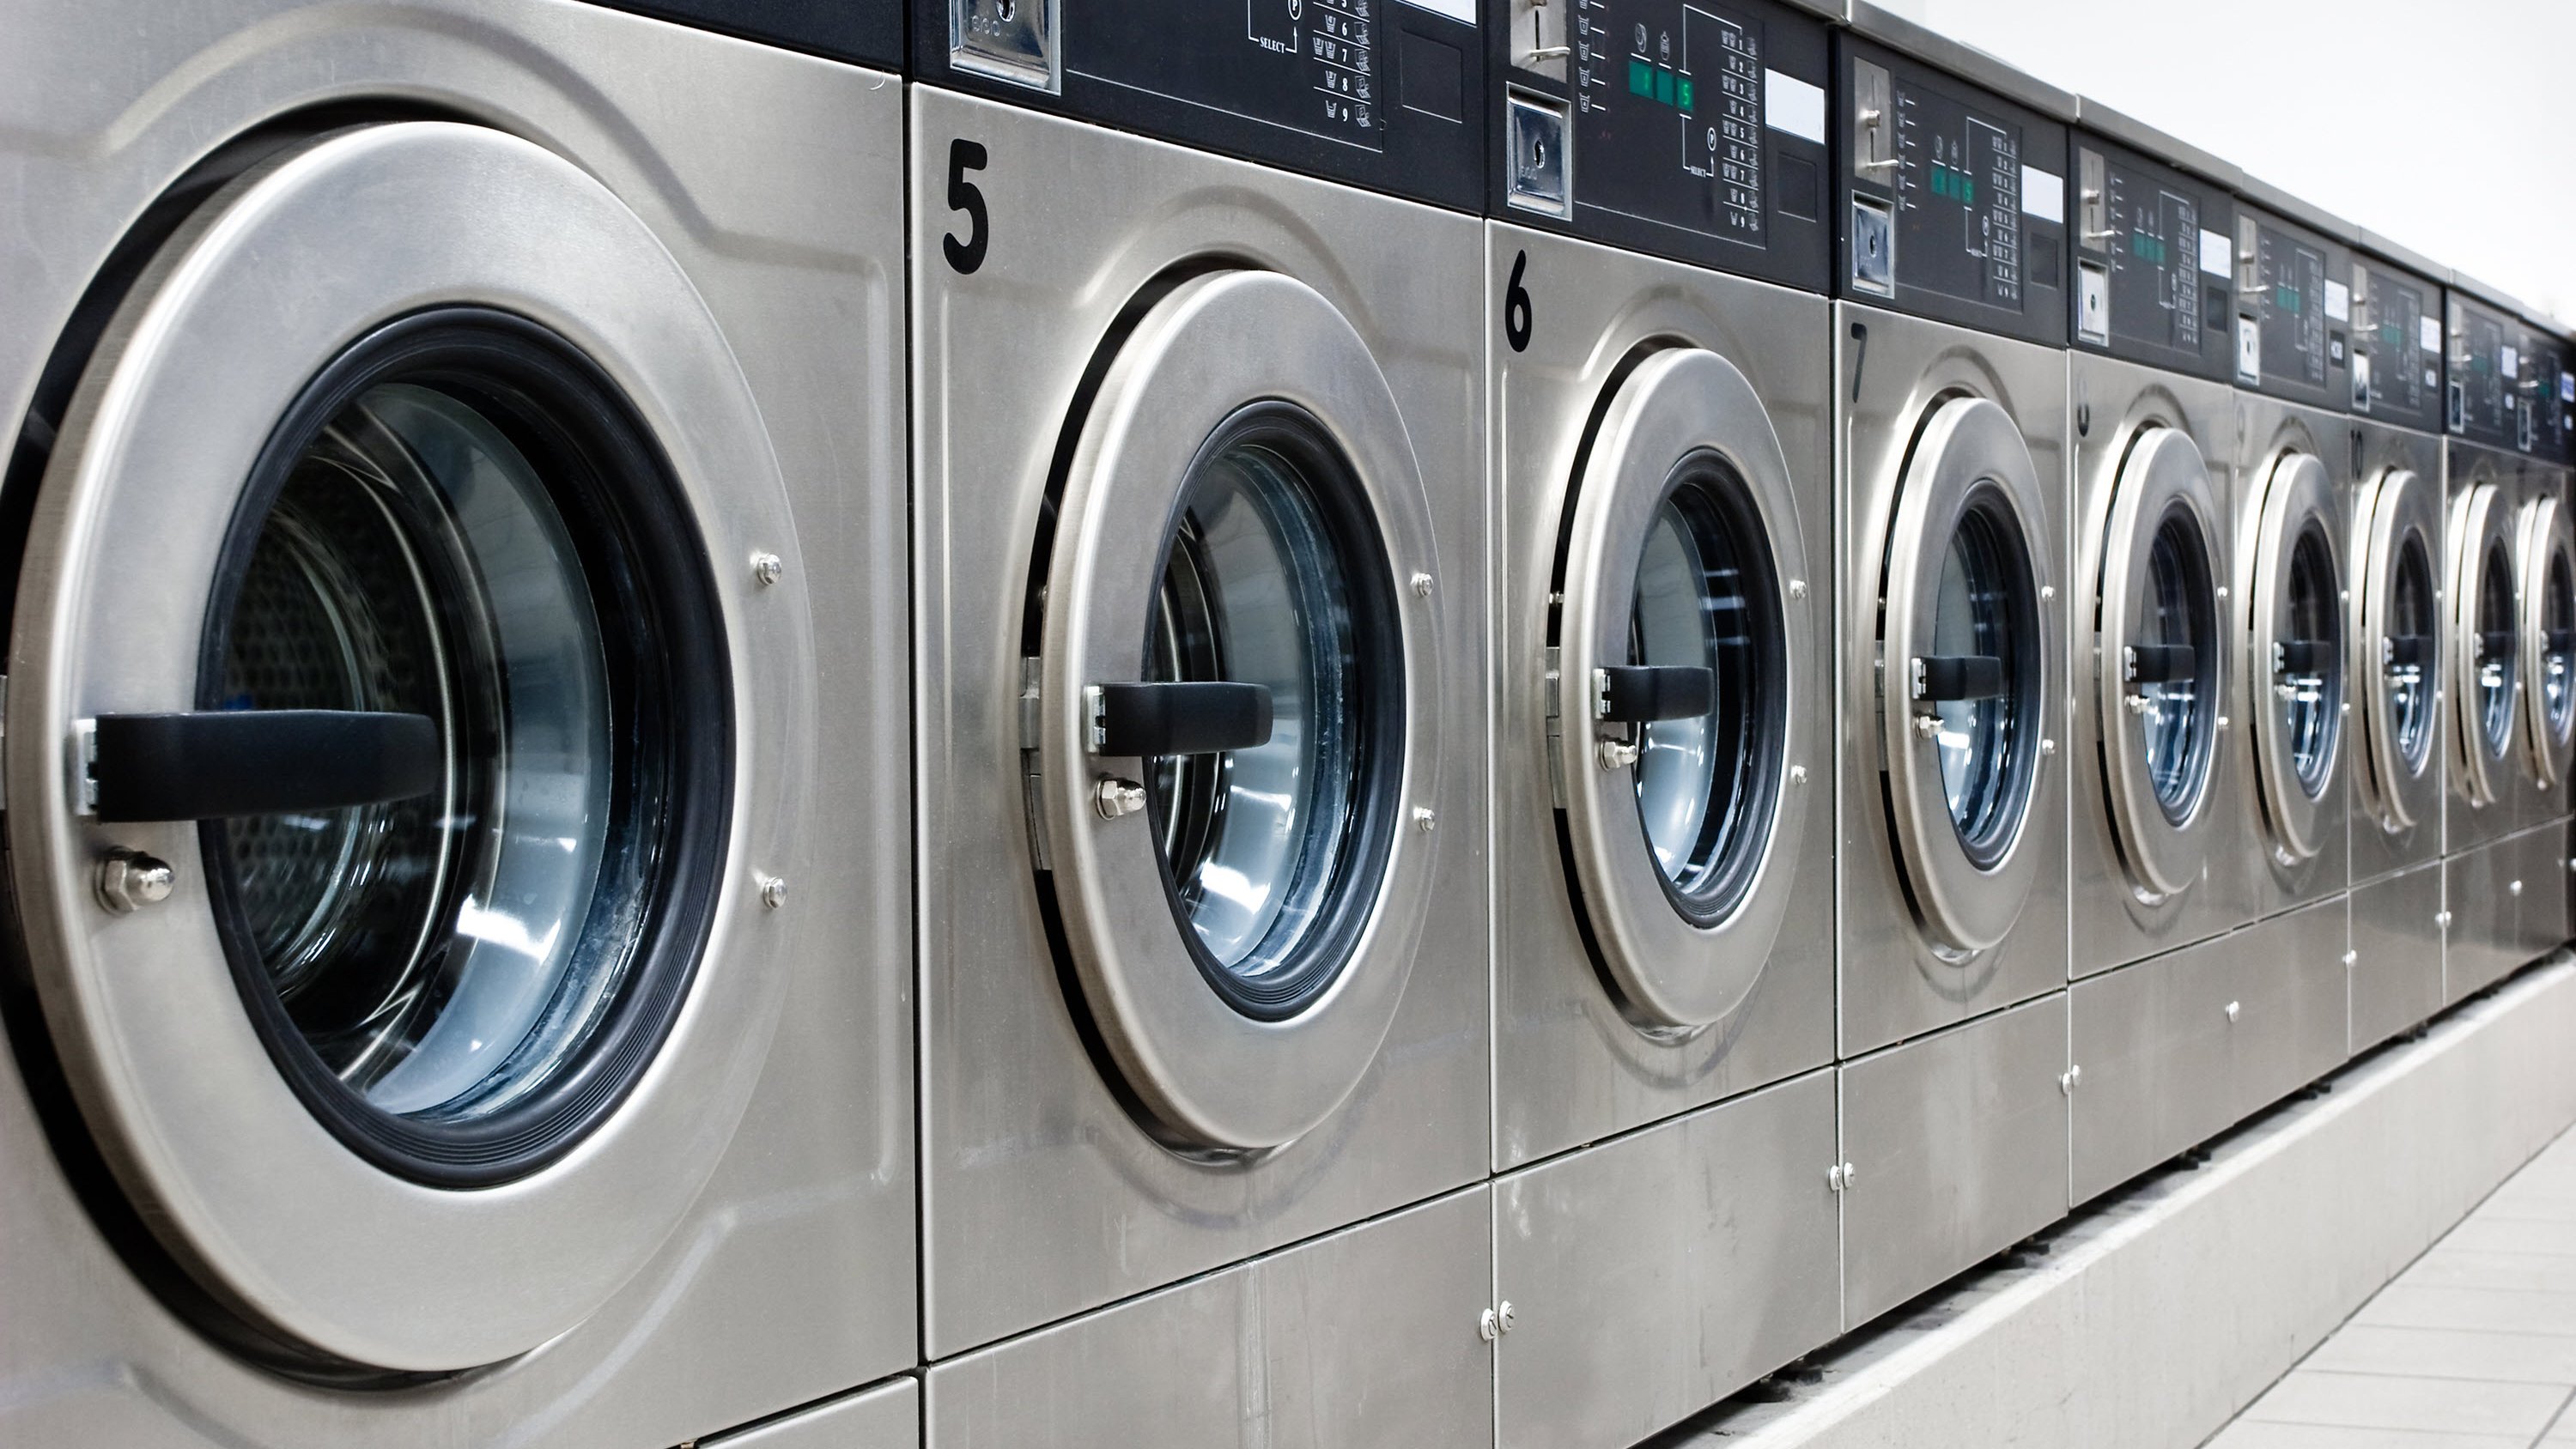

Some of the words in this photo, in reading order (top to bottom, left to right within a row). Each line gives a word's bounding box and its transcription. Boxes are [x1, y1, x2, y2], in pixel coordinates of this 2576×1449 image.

[1341, 22, 1347, 36] 6
[1260, 36, 1285, 53] SELECT
[1342, 48, 1347, 63] 7
[1739, 62, 1744, 73] 2
[1342, 77, 1348, 92] 8
[1684, 83, 1691, 106] 5
[1342, 107, 1348, 122] 9
[1690, 165, 1706, 178] SELECT
[1741, 170, 1745, 181] 7
[944, 138, 988, 275] 5
[1505, 249, 1532, 353] 6
[1850, 322, 1868, 403] 7
